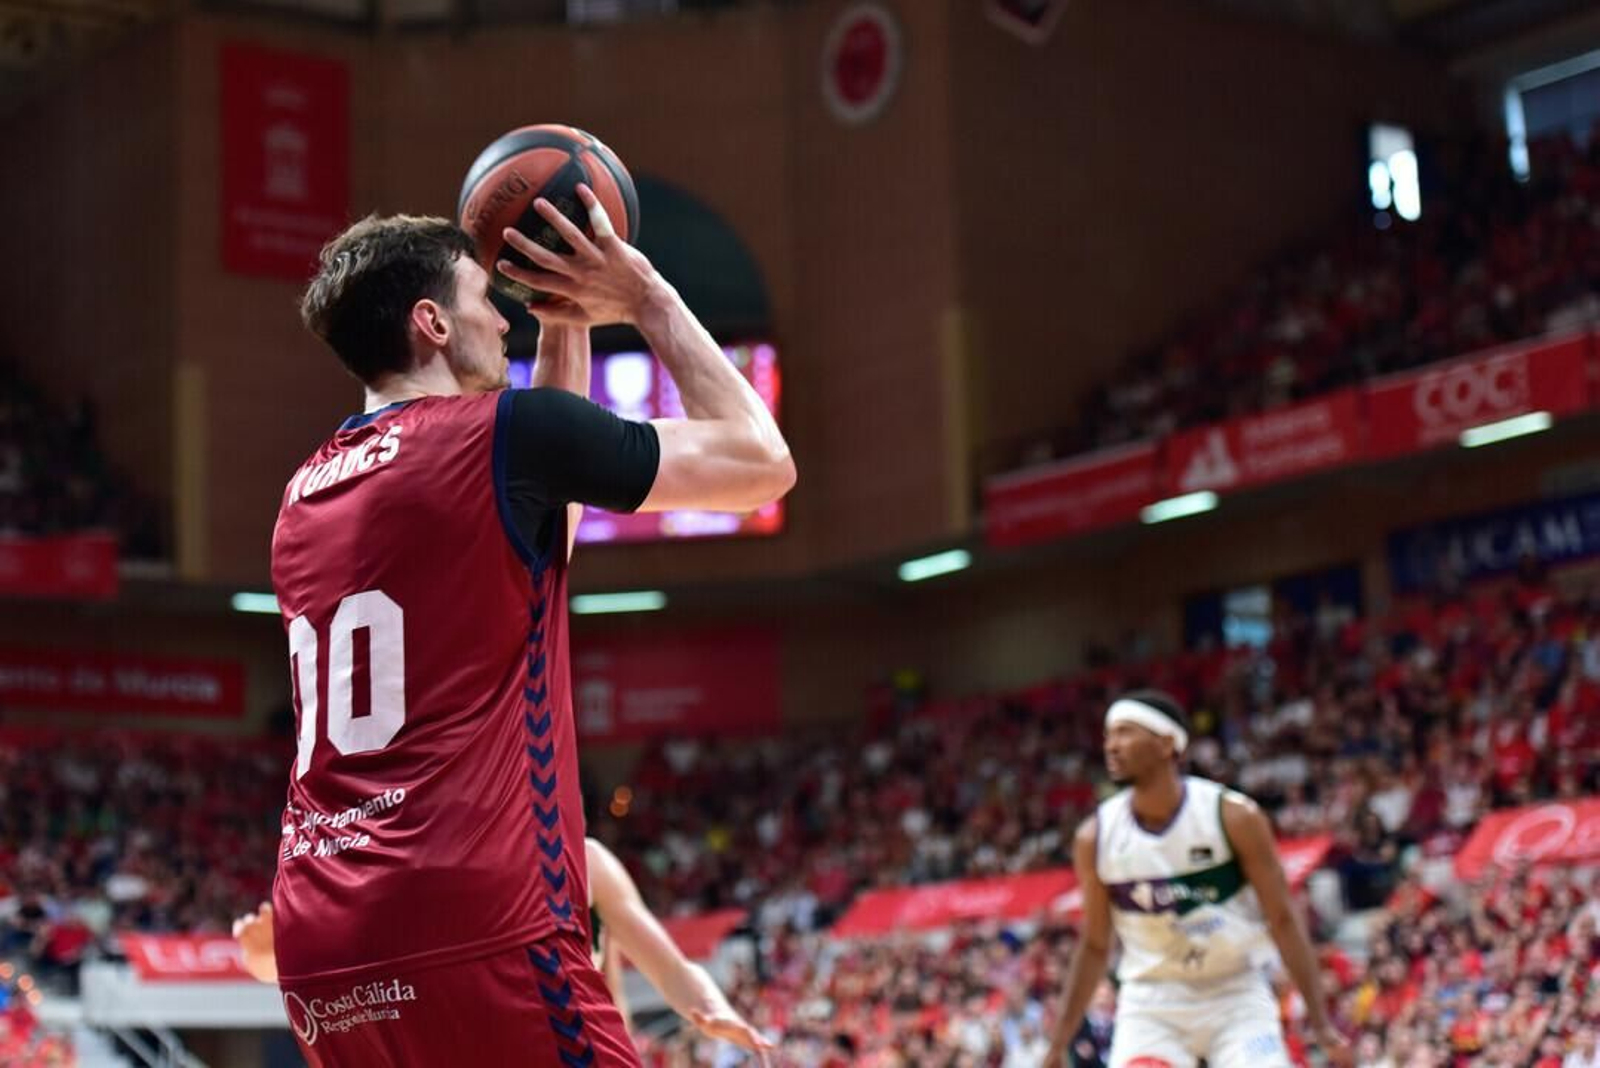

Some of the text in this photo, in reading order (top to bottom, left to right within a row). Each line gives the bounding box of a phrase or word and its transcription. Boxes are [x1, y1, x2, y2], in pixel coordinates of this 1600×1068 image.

[299, 788, 406, 834] Aytamiento
[293, 835, 312, 857] de
[353, 979, 417, 1007] Cálida
